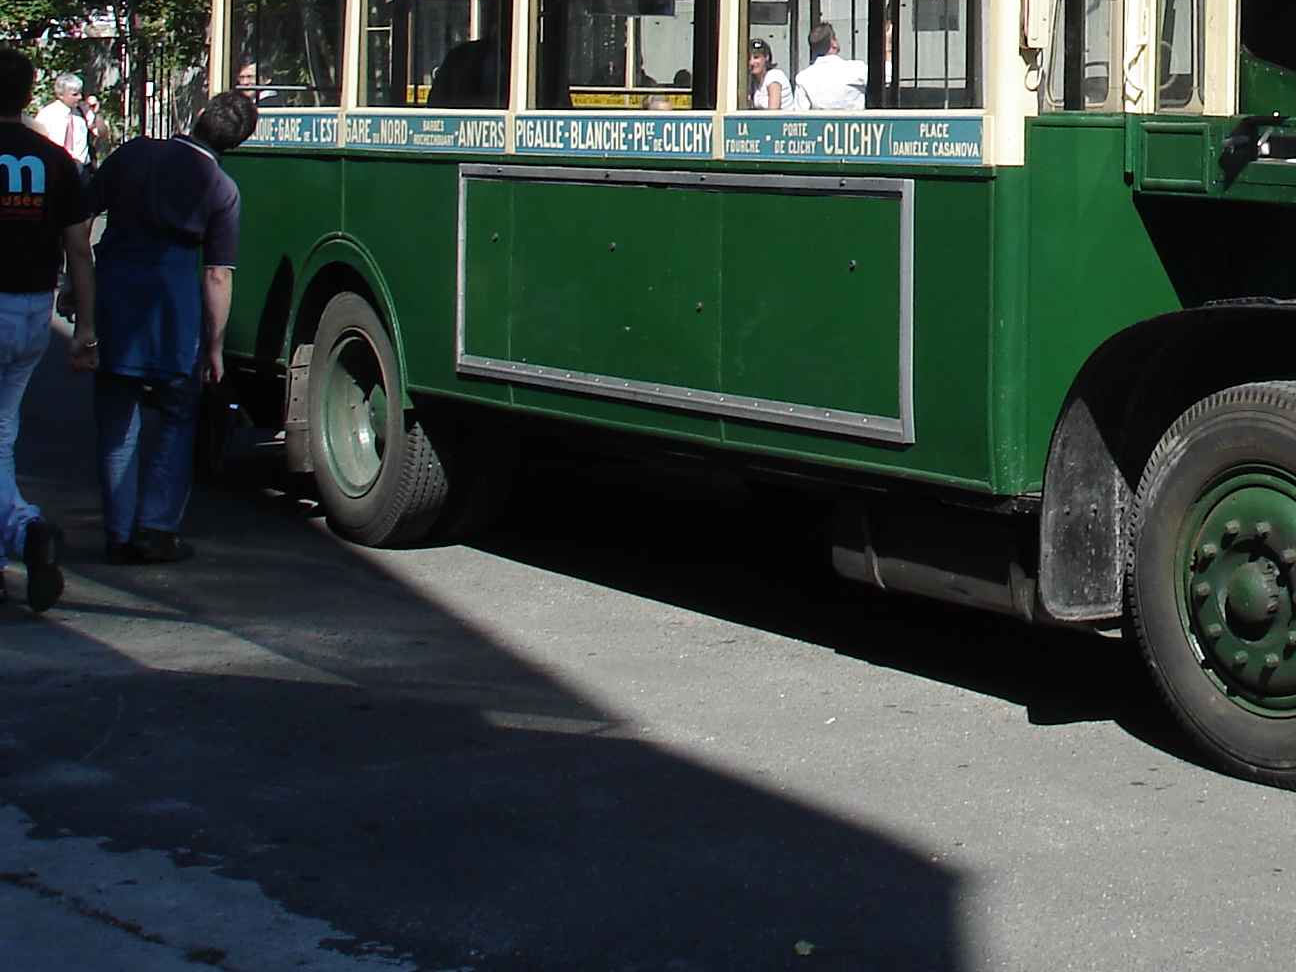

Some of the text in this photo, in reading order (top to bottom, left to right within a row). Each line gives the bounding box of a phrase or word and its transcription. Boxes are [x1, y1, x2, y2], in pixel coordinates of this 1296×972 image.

[278, 118, 302, 142] GARE
[312, 118, 338, 143] L'EST
[346, 118, 372, 144] GARE
[380, 119, 408, 145] NORD
[458, 120, 505, 148] ANVERS
[516, 119, 564, 149] PIGALLE
[570, 120, 628, 151] BLANCHE
[663, 122, 713, 153] CLICHY
[738, 122, 749, 136] LA
[782, 122, 808, 137] PORTE
[823, 122, 885, 157] CLICHY
[919, 122, 949, 139] PLACE
[725, 139, 761, 154] FOURCHE
[774, 140, 817, 155] DE CLICHY
